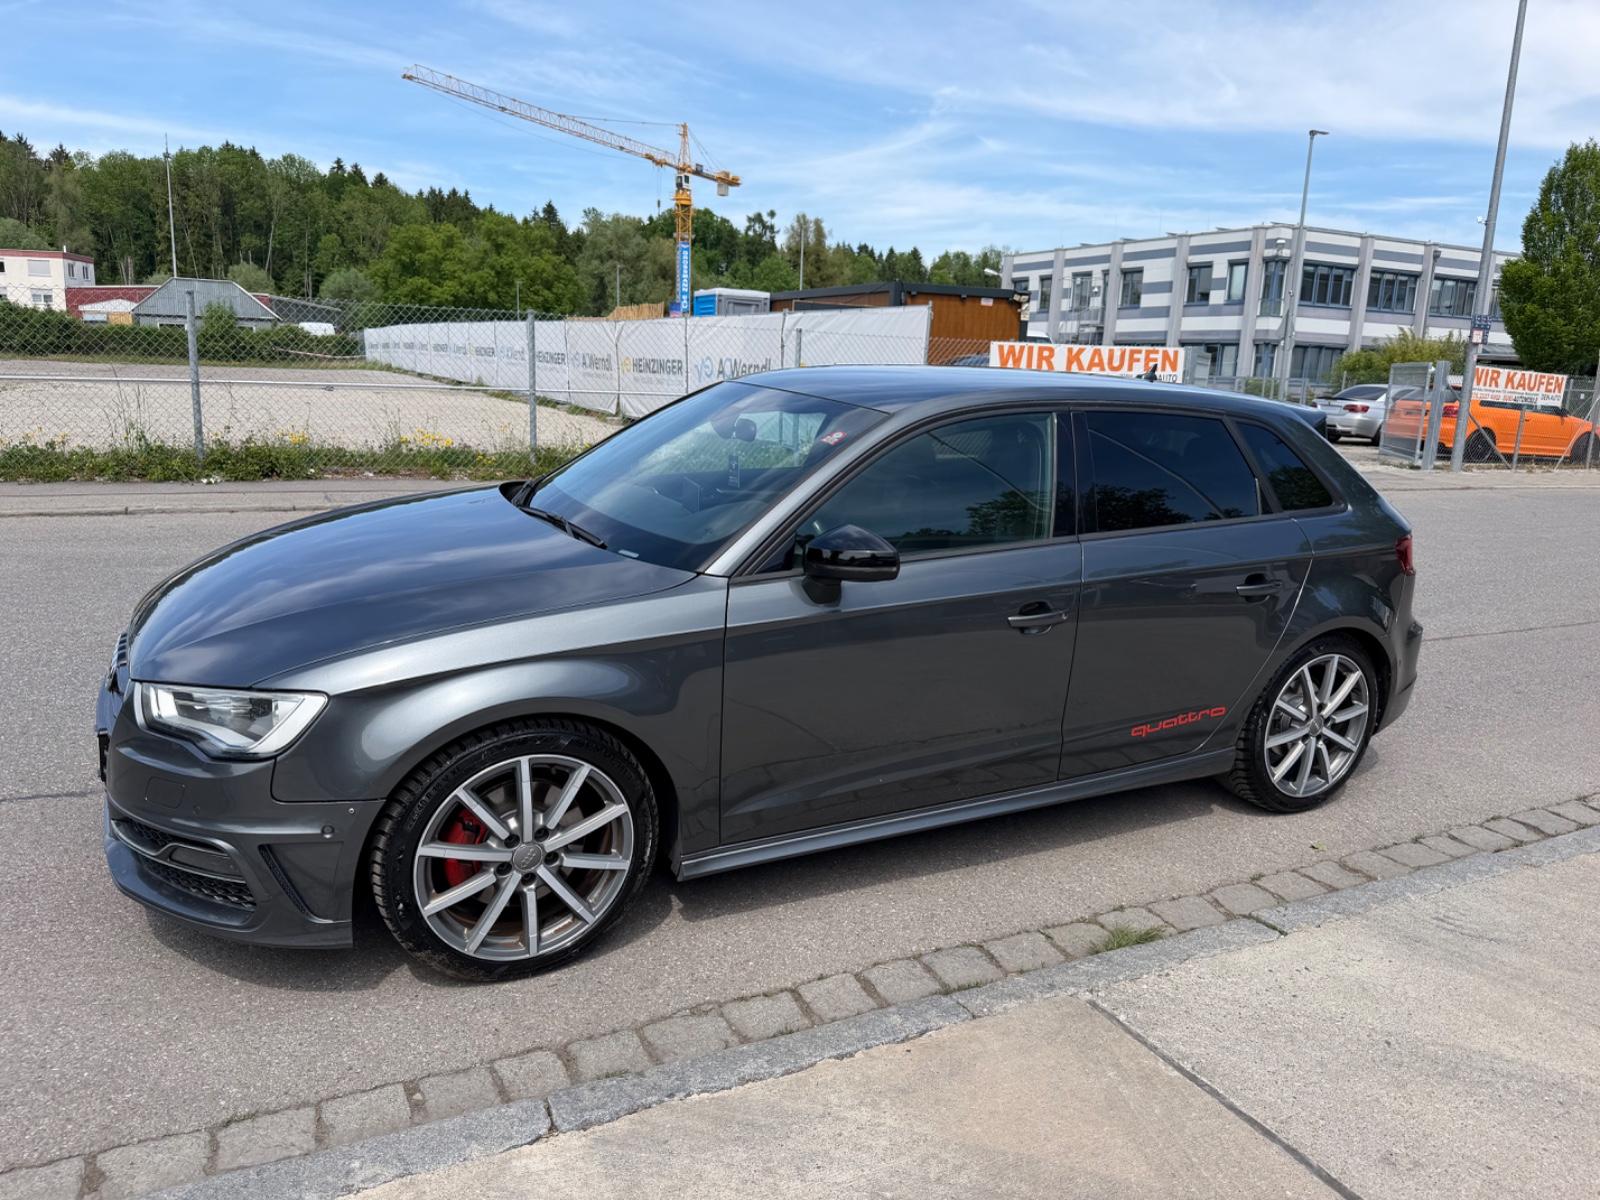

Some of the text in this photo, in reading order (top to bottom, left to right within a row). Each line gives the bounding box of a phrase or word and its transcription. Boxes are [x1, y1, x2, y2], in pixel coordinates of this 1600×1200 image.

[997, 344, 1179, 372] WIR KAUFEN
[1504, 371, 1564, 394] KAUFEN
[1131, 706, 1227, 737] quattro
